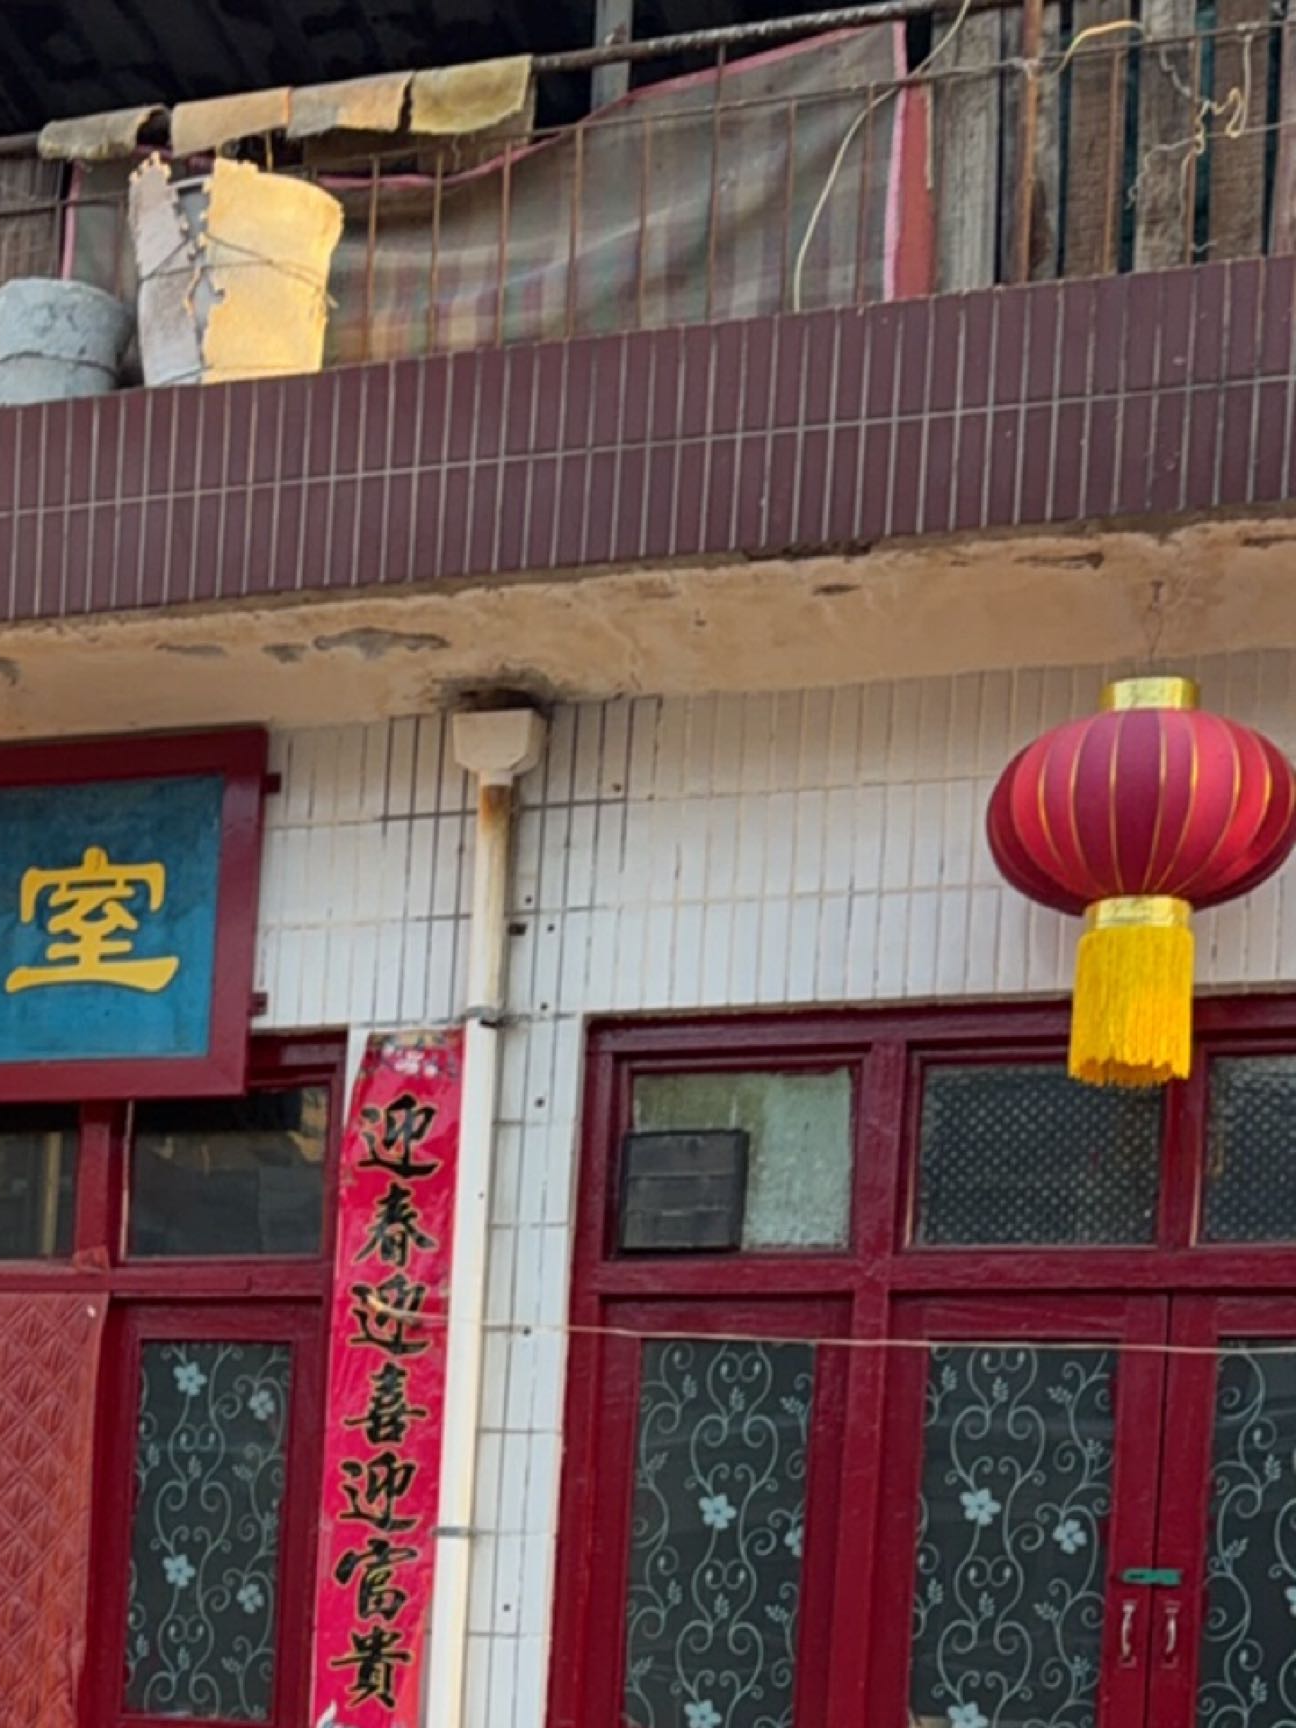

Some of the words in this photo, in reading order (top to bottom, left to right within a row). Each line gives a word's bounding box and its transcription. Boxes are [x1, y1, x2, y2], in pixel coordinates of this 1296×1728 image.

[331, 1093, 442, 1710] 迎春迎喜迎富貴
